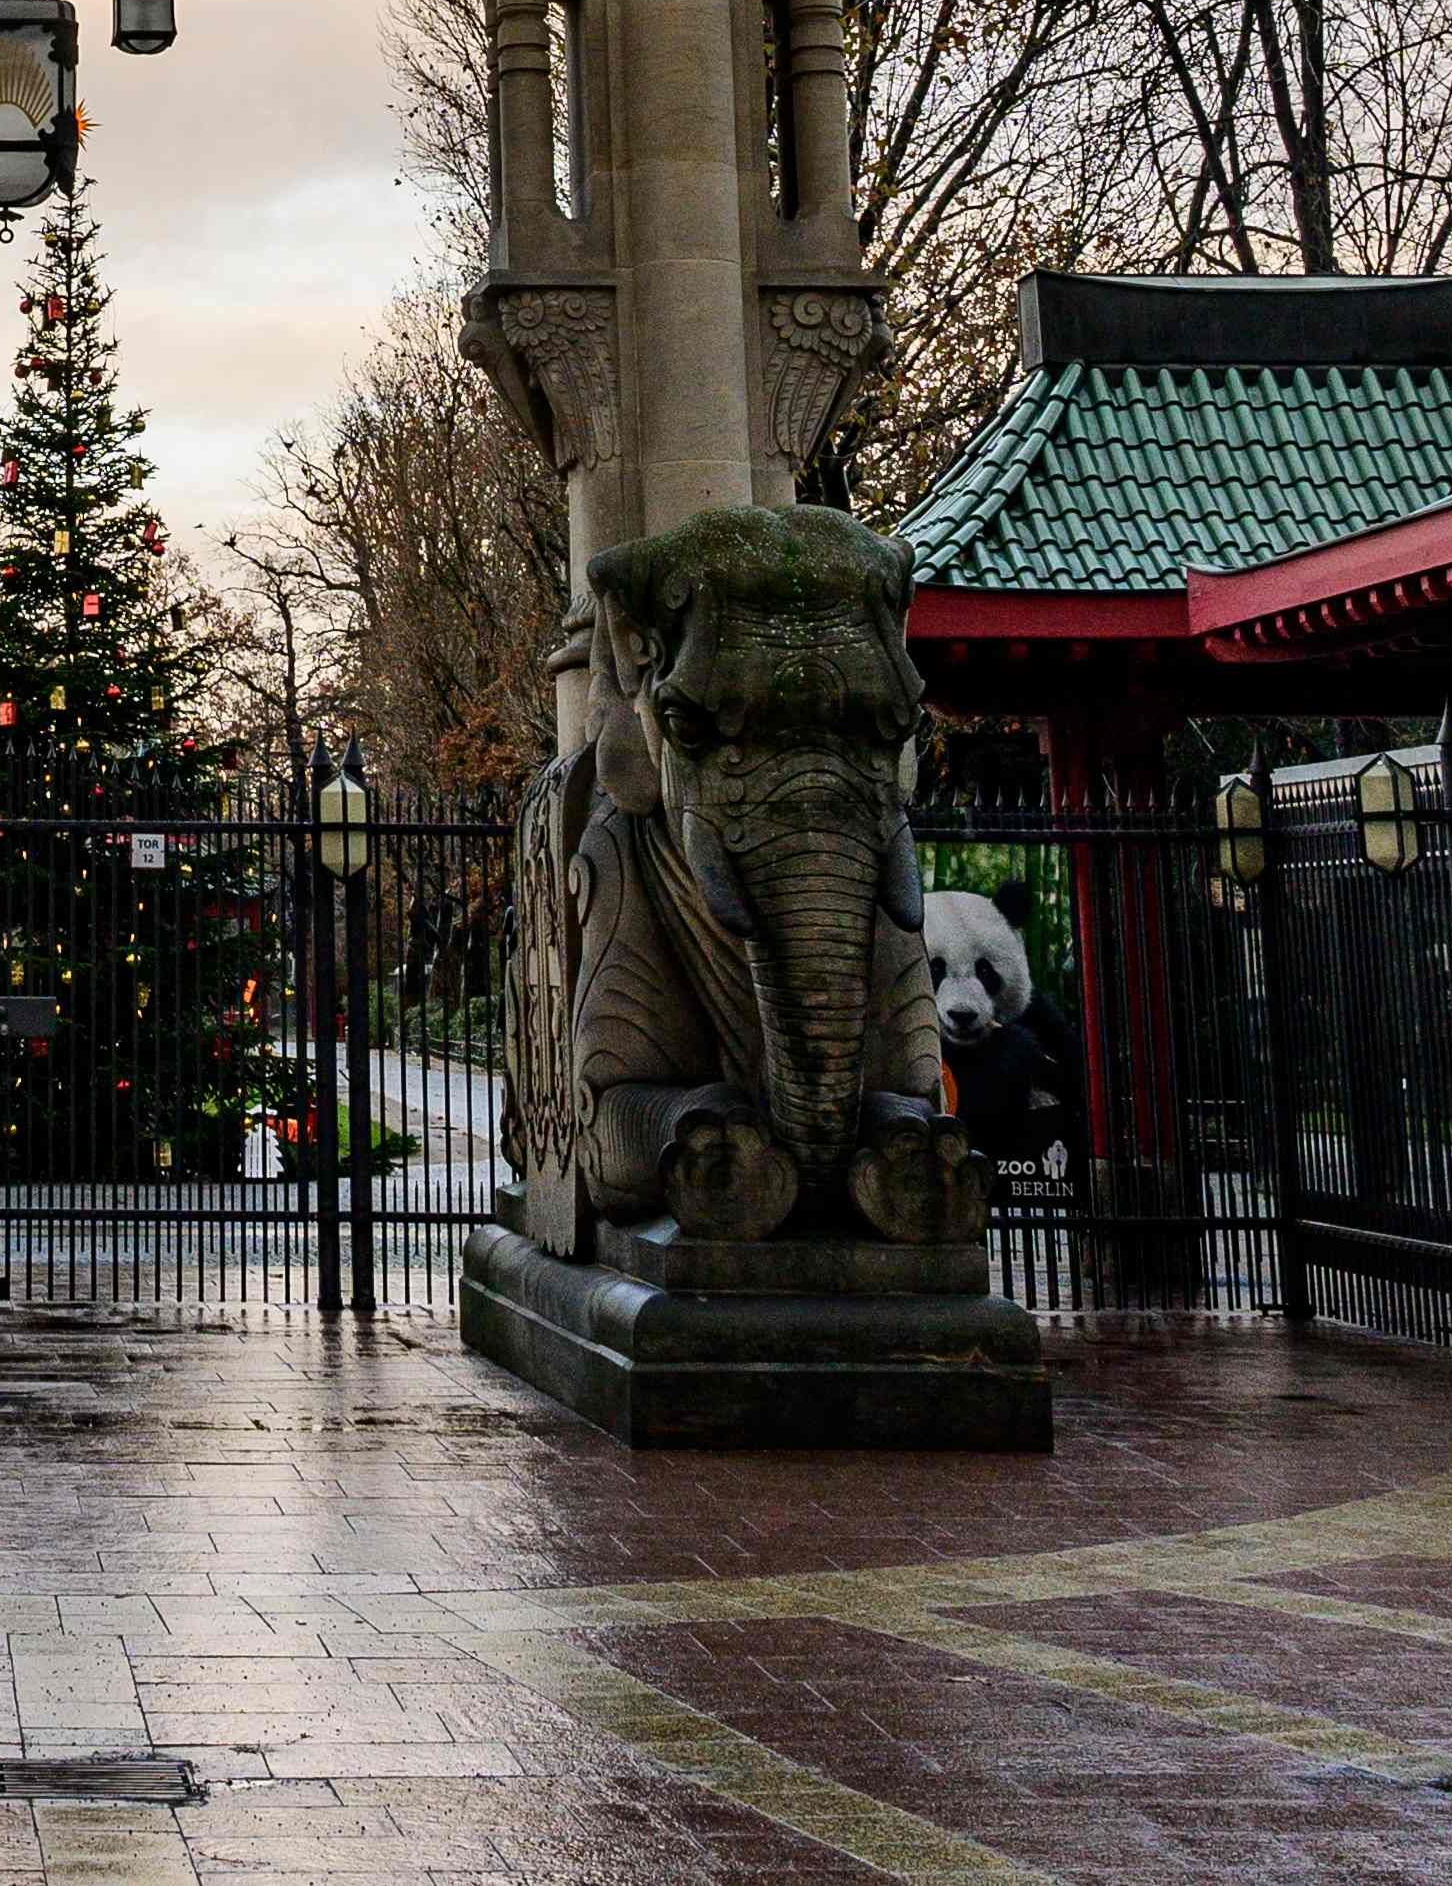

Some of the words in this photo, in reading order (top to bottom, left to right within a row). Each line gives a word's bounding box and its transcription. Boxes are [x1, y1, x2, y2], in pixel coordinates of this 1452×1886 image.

[137, 839, 159, 849] TOR
[142, 854, 154, 863] 12
[997, 1160, 1036, 1175] ZOO
[1010, 1181, 1074, 1197] BERLIN
